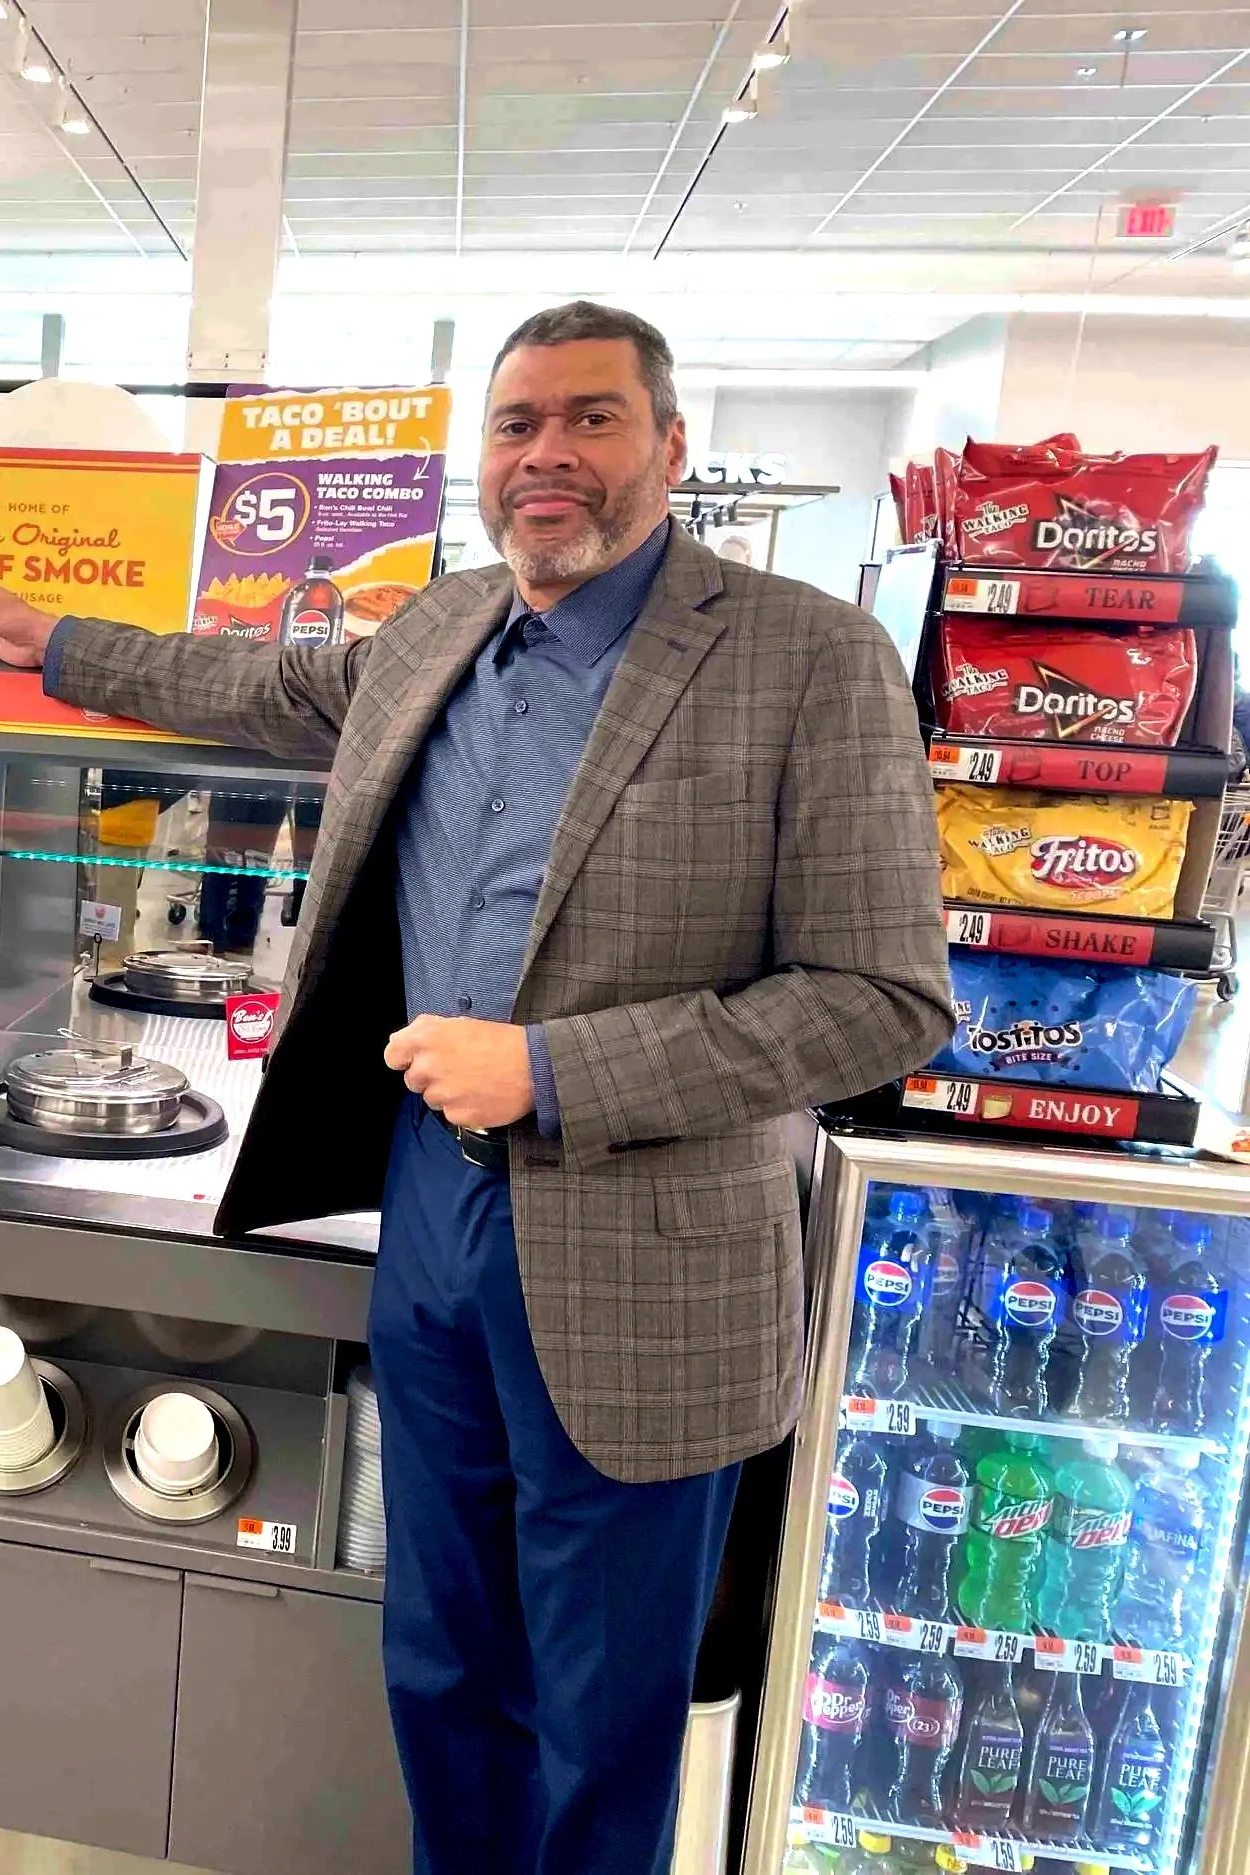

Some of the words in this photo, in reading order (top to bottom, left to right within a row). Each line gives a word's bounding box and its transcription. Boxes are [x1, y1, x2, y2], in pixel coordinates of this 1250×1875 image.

[242, 402, 324, 428] TACO
[334, 397, 434, 422] 'BOUT
[269, 429, 292, 451] A
[300, 423, 397, 450] DEAL!
[318, 474, 394, 486] WALKING
[317, 487, 359, 499] TACO
[362, 488, 424, 500] COMBO
[8, 503, 46, 513] HOME
[51, 504, 70, 514] OF
[234, 488, 296, 541] $5
[963, 505, 1029, 530] WALKING
[12, 523, 121, 556] Original
[1037, 521, 1158, 553] Doritos
[23, 555, 145, 587] SMOKE
[1086, 587, 1155, 609] TEAR
[293, 625, 328, 635] PEPSI
[1018, 686, 1135, 724] Doritos
[1078, 760, 1131, 781] TOP
[1031, 837, 1138, 878] Fritos
[1046, 929, 1136, 956] SHAKE
[233, 1009, 264, 1023] Ben's
[1005, 1054, 1027, 1064] BITE
[1031, 1052, 1051, 1061] SIZE
[1028, 1098, 1121, 1127] ENJOY
[867, 1274, 910, 1292] PEPSI
[1008, 1296, 1052, 1309] PEPSI
[1076, 1303, 1120, 1321] PEPSI
[1163, 1310, 1209, 1323] PEPSI
[922, 1501, 965, 1515] PEPSI
[982, 1746, 1020, 1759] PURE
[979, 1757, 1020, 1770] LEAF
[1049, 1756, 1087, 1770] PURE
[1047, 1766, 1085, 1781] LEAF
[1121, 1764, 1161, 1781] PURE
[1119, 1775, 1160, 1788] LEAF
